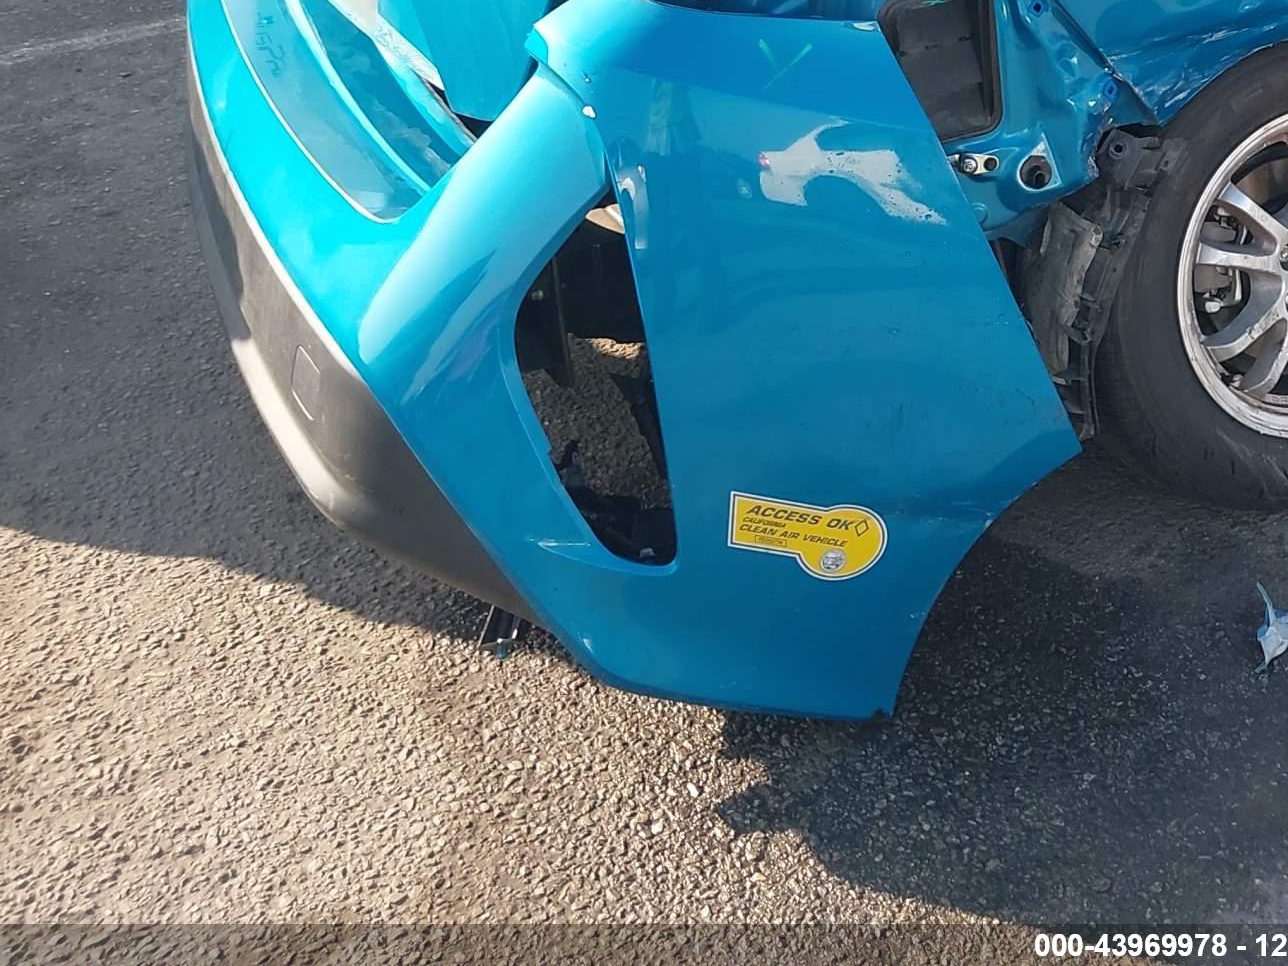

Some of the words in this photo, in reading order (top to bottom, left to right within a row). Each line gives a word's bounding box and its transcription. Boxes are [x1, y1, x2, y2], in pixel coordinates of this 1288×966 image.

[746, 505, 823, 525] ACCESS
[827, 518, 855, 531] OK
[739, 523, 777, 536] CLEAN
[779, 530, 800, 539] AIR
[803, 533, 848, 548] VEHICLE
